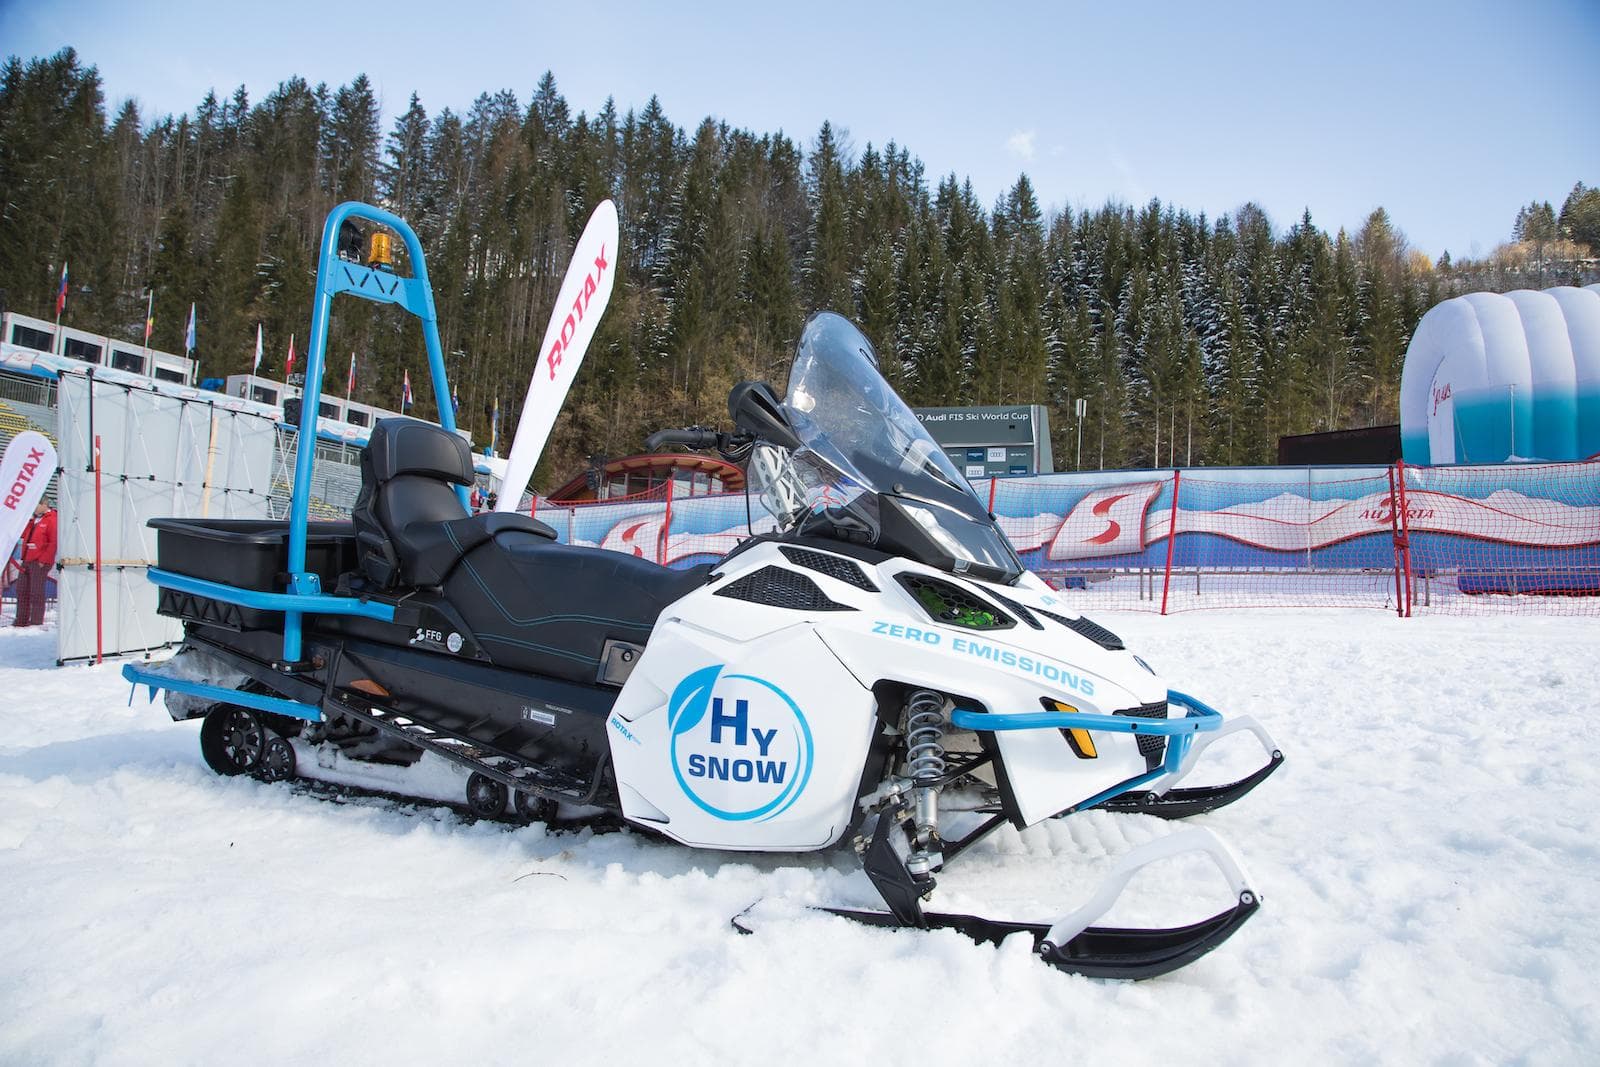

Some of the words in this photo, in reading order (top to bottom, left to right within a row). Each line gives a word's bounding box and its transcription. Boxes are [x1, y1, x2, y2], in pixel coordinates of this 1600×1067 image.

[546, 242, 608, 382] ROTAX
[925, 413, 947, 422] Audi
[949, 413, 964, 421] FIS
[966, 413, 980, 421] Ski
[981, 412, 1009, 421] World
[1011, 412, 1029, 422] Cup
[3, 446, 46, 511] ROTAX
[425, 629, 442, 642] FFG
[872, 621, 941, 645] ZERO
[952, 638, 1096, 697] EMISSIONS
[611, 717, 633, 741] ROTAX
[688, 753, 787, 784] SNOW
